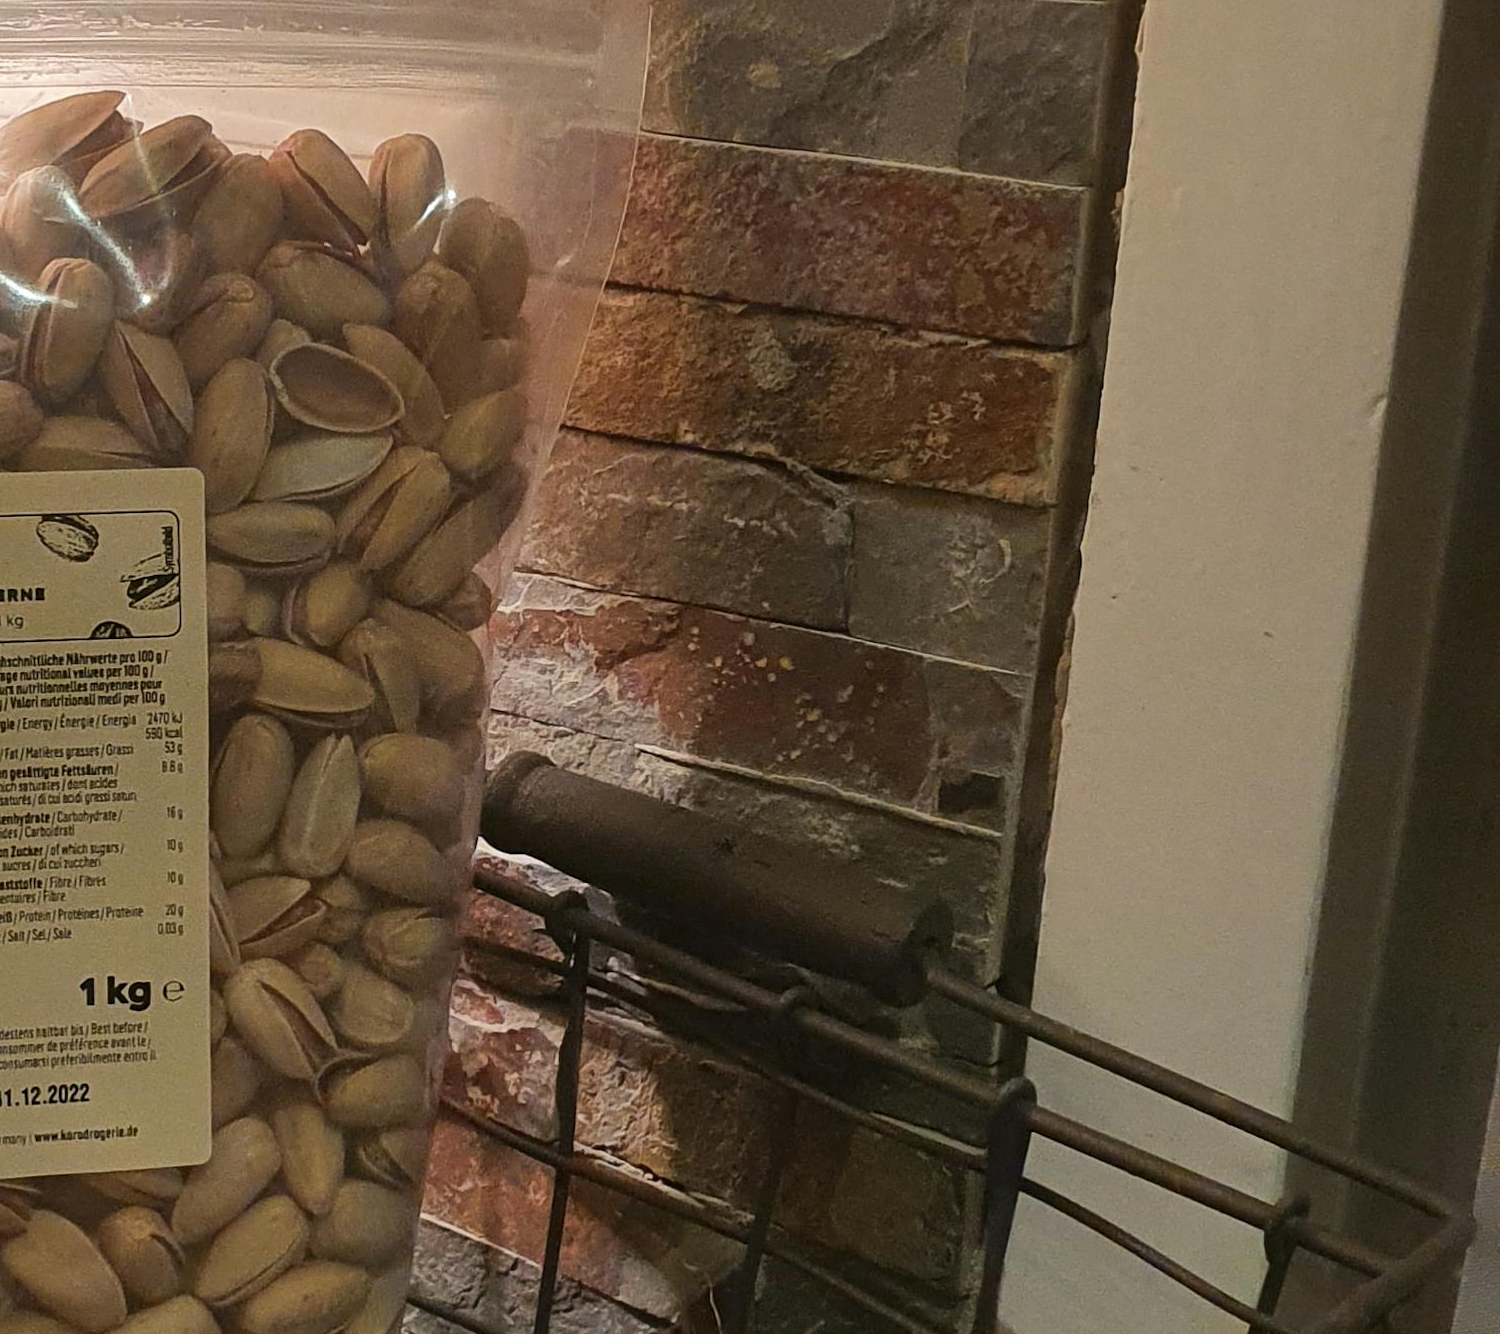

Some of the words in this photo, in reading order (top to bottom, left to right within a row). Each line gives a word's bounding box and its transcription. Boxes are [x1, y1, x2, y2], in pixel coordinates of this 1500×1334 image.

[6, 615, 25, 630] kg
[80, 977, 96, 1006] 1
[106, 975, 152, 1012] kg
